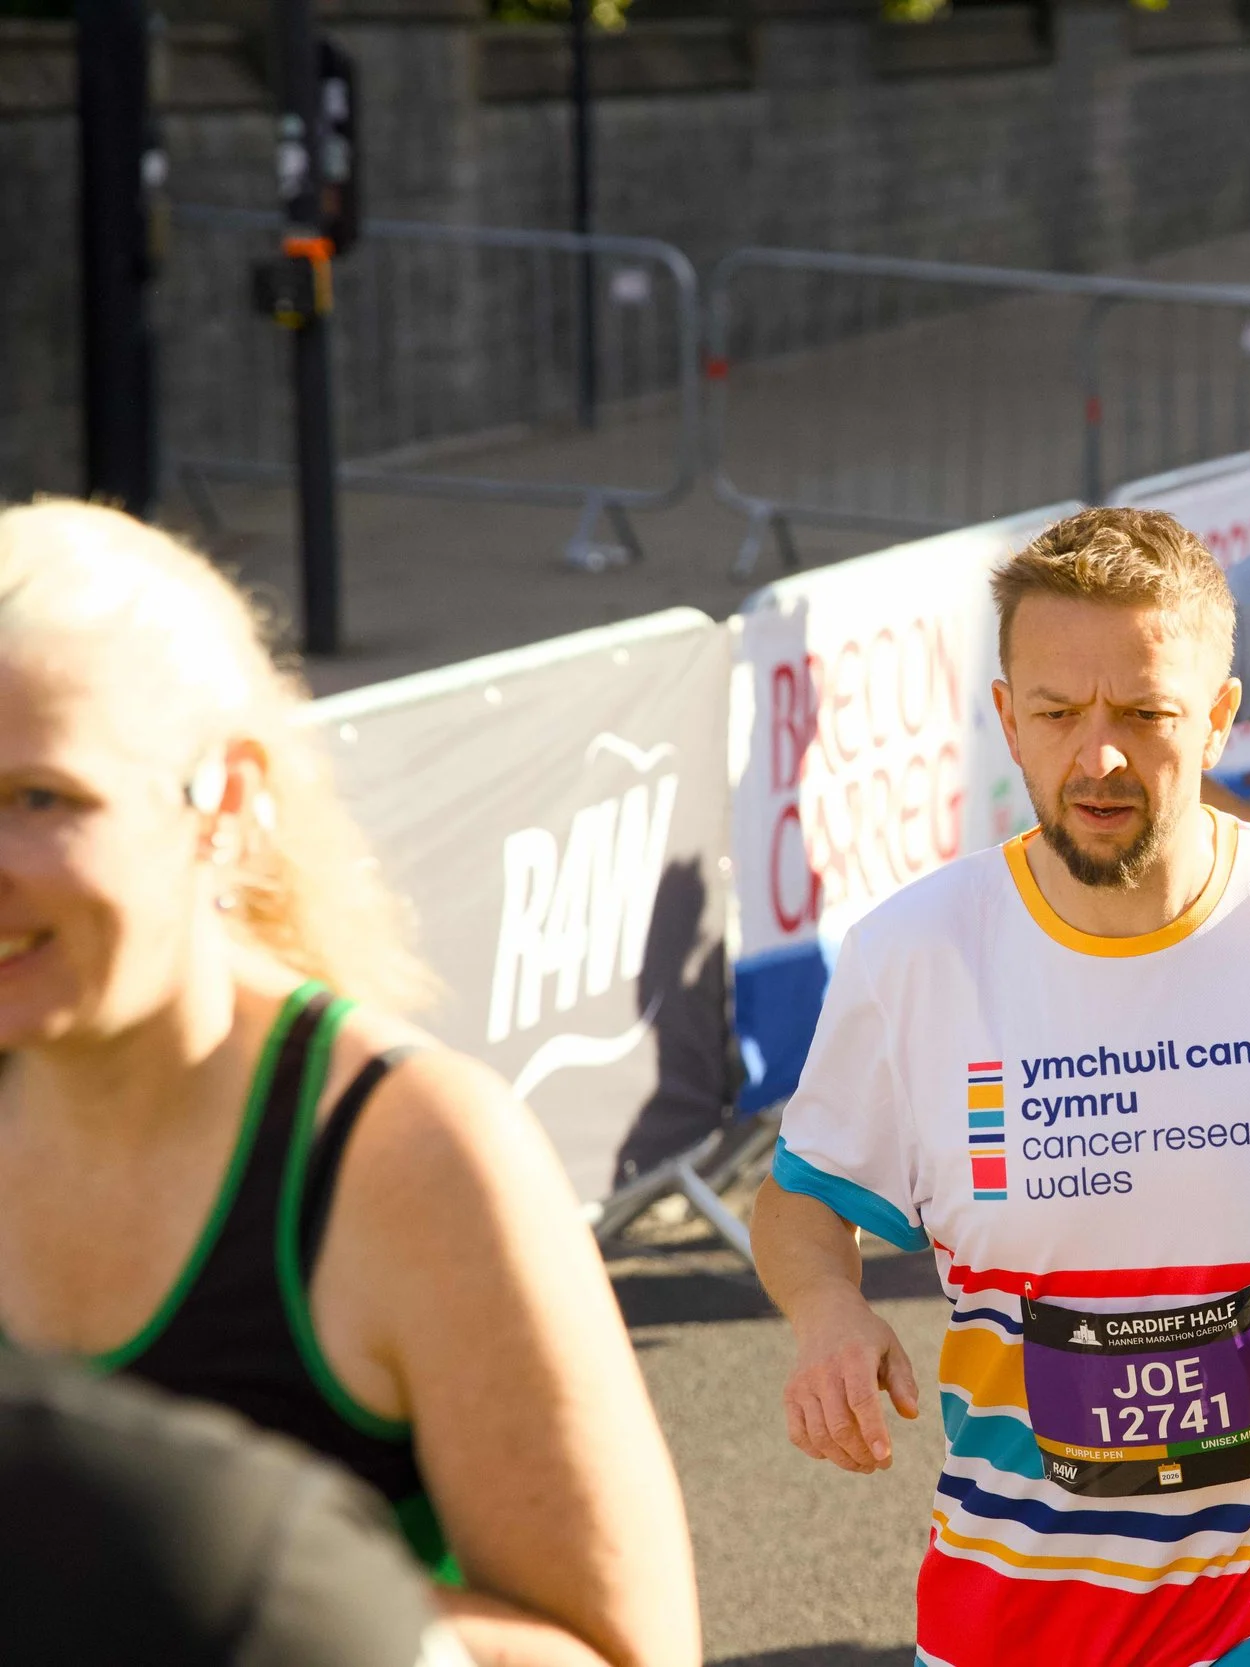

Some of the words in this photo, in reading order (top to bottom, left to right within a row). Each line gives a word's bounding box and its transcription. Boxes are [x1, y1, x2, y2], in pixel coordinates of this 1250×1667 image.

[1021, 1040, 1180, 1088] ymchwil
[1021, 1088, 1138, 1126] cymru
[1022, 1125, 1147, 1161] cancer
[1025, 1167, 1133, 1201] wales
[1106, 1315, 1185, 1336] CARDIFF
[1190, 1301, 1236, 1327] HALF
[1108, 1337, 1145, 1347] HANNER
[1145, 1331, 1194, 1344] MARATHON
[1195, 1318, 1238, 1337] CAERDYDD
[1113, 1357, 1203, 1399] JOE
[1092, 1392, 1231, 1442] 12741
[1065, 1447, 1101, 1459] PURPLE
[1103, 1450, 1124, 1459] PEN
[1201, 1433, 1238, 1450] UNISEX
[1052, 1461, 1078, 1480] R4W
[1161, 1472, 1180, 1481] 2026
